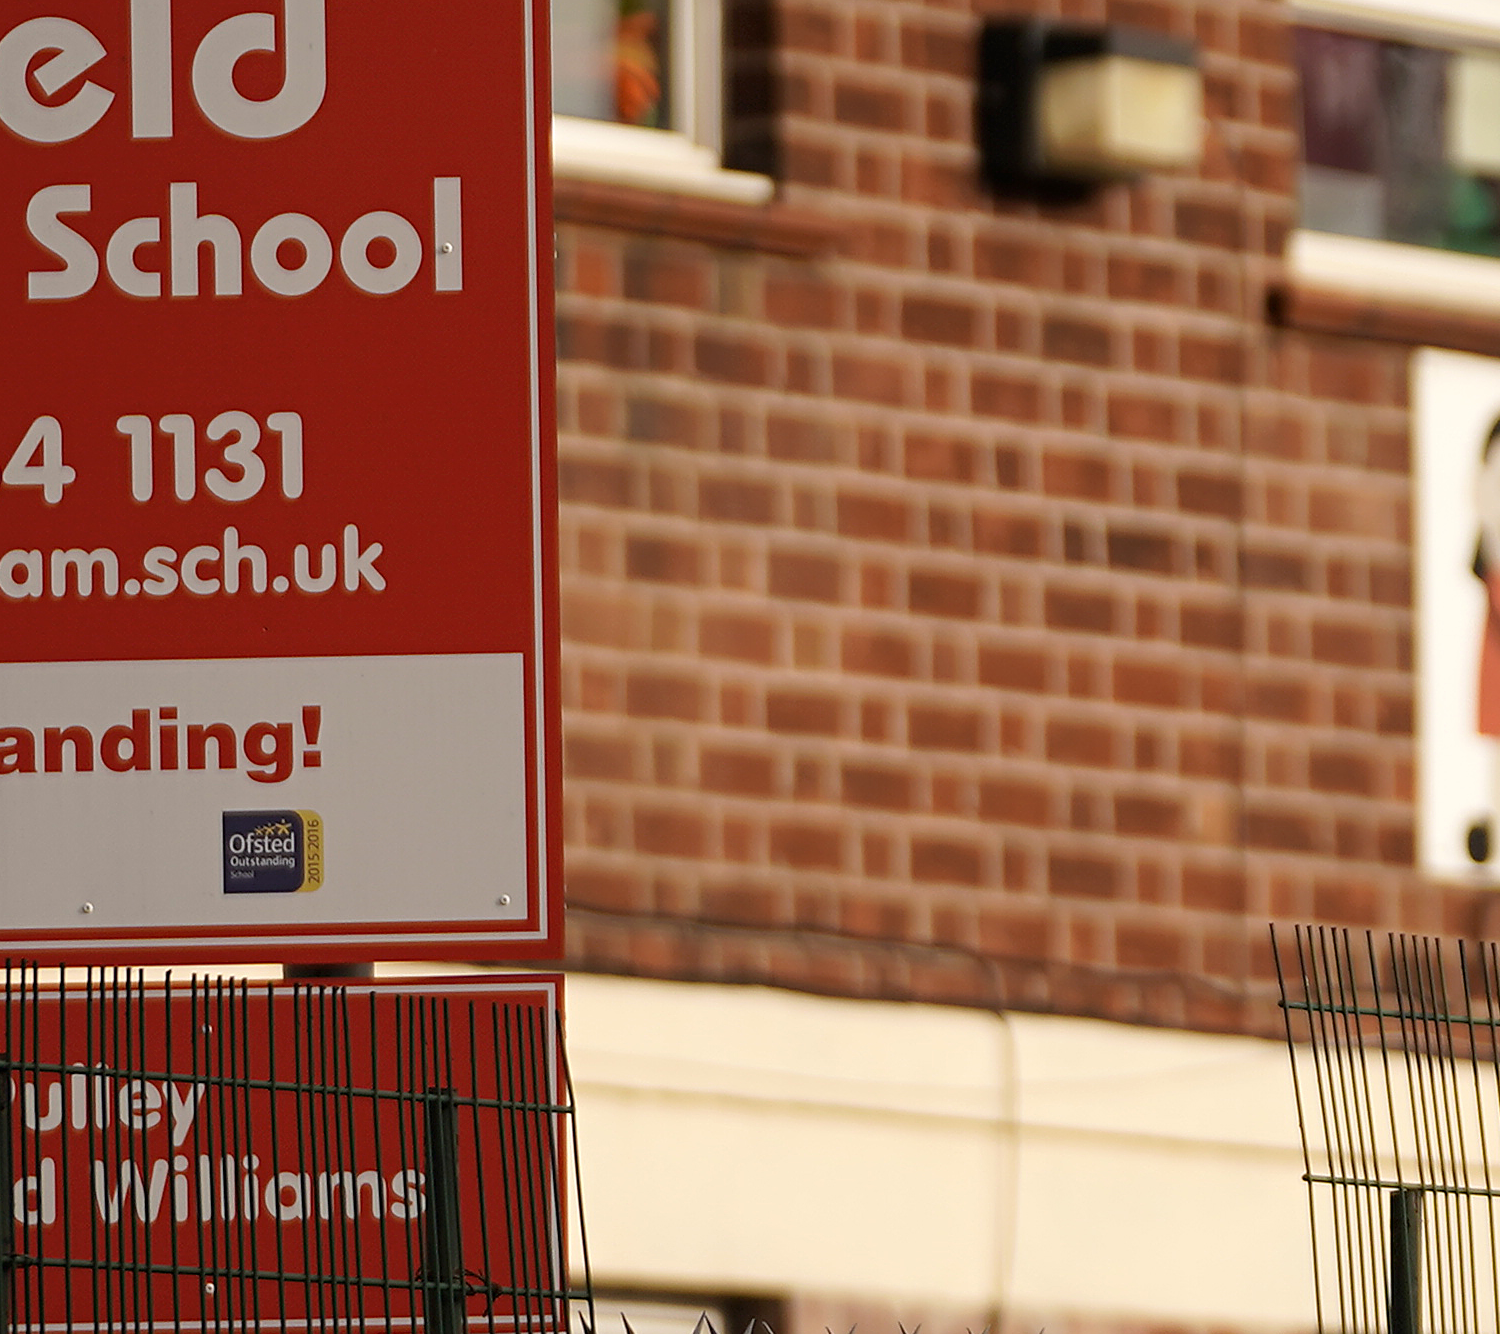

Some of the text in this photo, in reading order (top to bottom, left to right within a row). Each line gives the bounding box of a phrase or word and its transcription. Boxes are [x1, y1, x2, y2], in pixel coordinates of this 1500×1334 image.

[26, 175, 463, 301] School
[115, 410, 305, 503] 1131
[229, 832, 295, 853] Ofsted
[230, 855, 295, 869] Outstanding
[306, 819, 321, 883] 2015 2016
[92, 1153, 426, 1225] Williams
